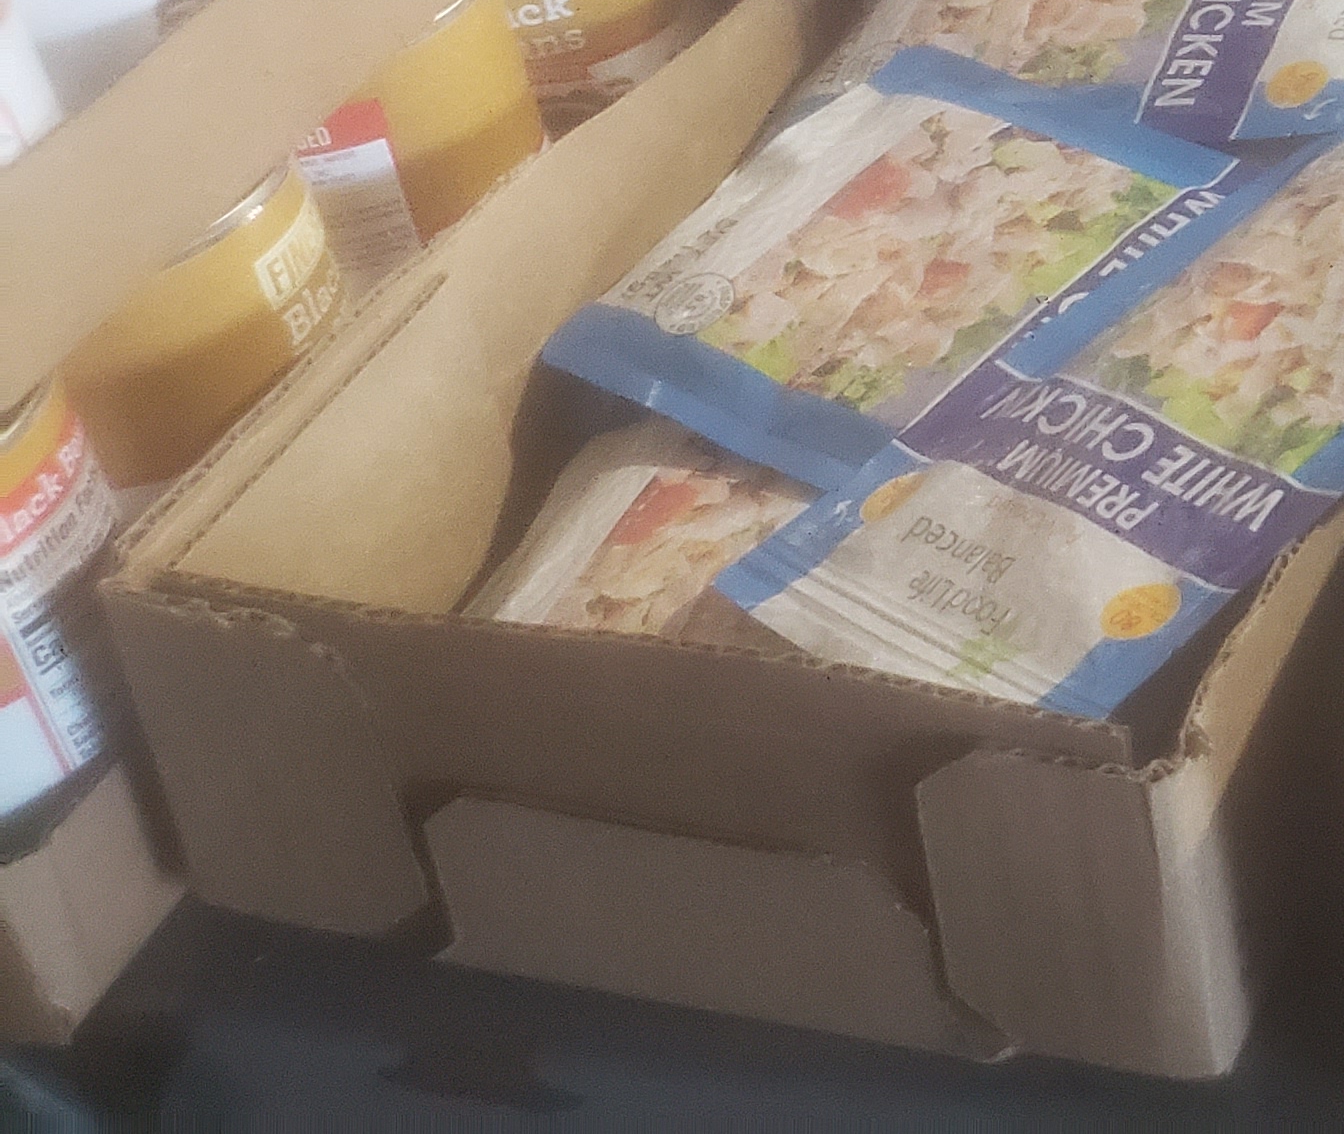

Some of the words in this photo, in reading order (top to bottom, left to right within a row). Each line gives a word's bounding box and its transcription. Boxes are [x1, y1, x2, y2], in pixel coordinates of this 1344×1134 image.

[997, 439, 1159, 531] PREMIUM
[1158, 443, 1284, 532] WHITE
[901, 515, 1018, 583] Balanced
